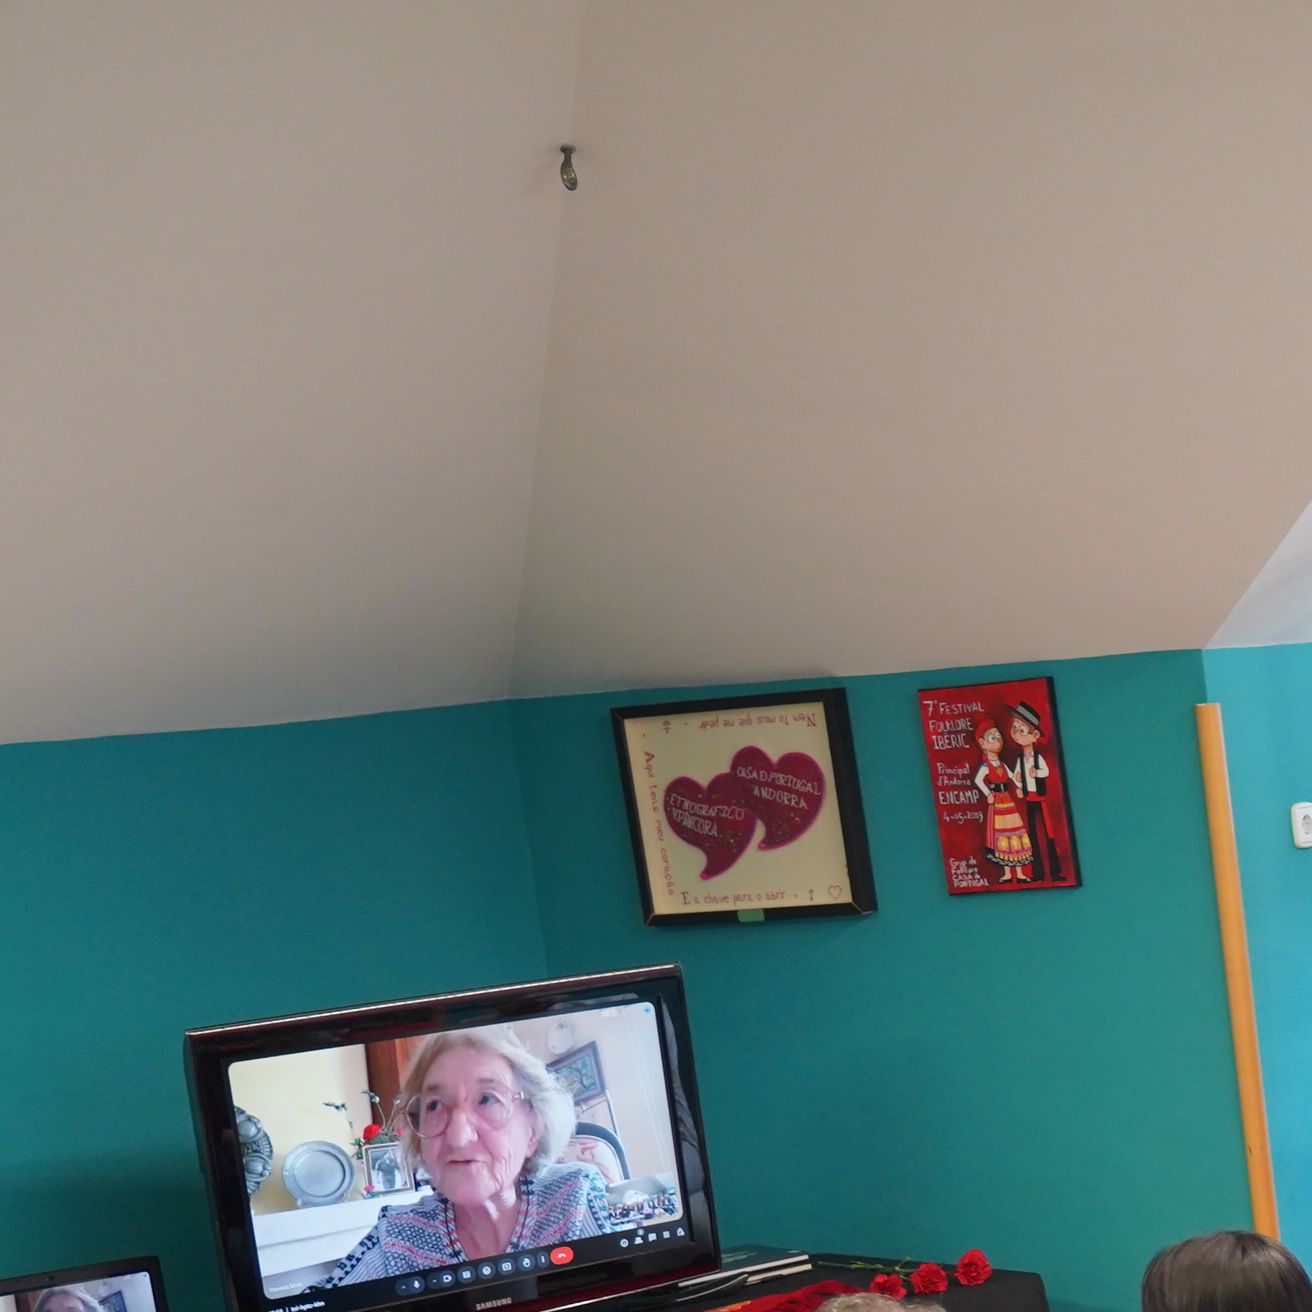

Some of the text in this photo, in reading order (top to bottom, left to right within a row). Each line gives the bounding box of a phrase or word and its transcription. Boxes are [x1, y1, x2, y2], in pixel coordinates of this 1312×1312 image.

[939, 702, 985, 715] FESTIVAL
[929, 717, 974, 732] FOLKLORE
[936, 762, 970, 779] Principal
[938, 790, 980, 805] ENCAMP
[475, 1297, 513, 1311] SAMSUNG
